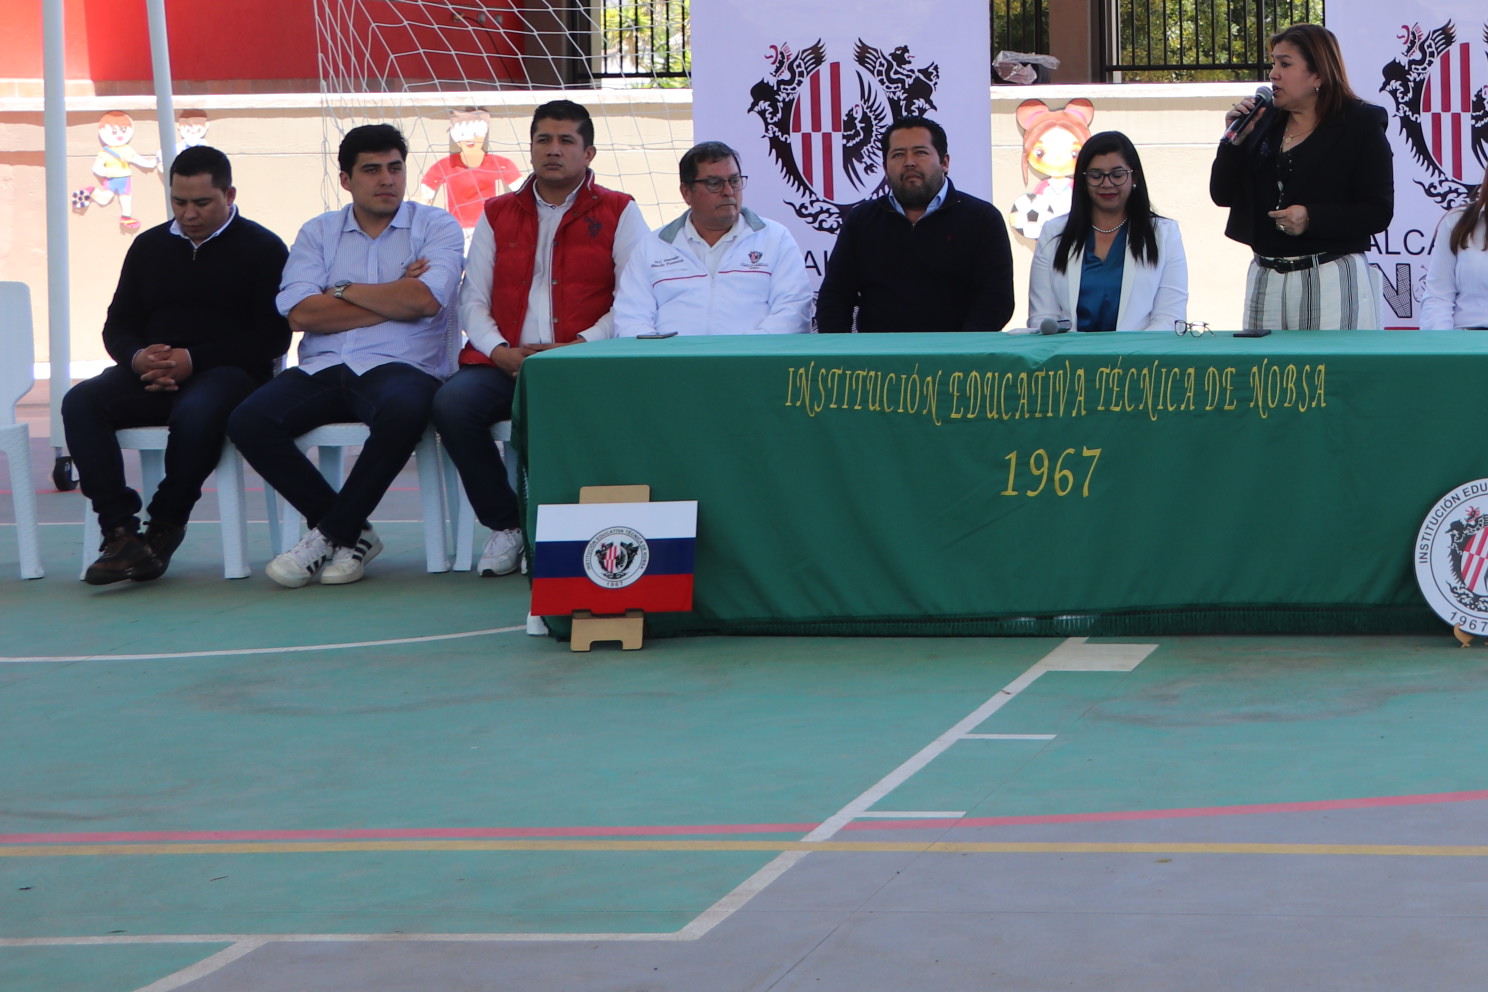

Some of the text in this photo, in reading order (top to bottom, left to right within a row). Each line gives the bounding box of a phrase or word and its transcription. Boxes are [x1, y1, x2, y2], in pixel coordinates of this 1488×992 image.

[785, 356, 1327, 426] INSTITUCIÓN EDUCATIVA TÉCNICA DE NOBSA
[1000, 445, 1102, 498] 1967
[1419, 493, 1461, 564] INSTITUCIÓN
[1450, 611, 1488, 633] 1967
